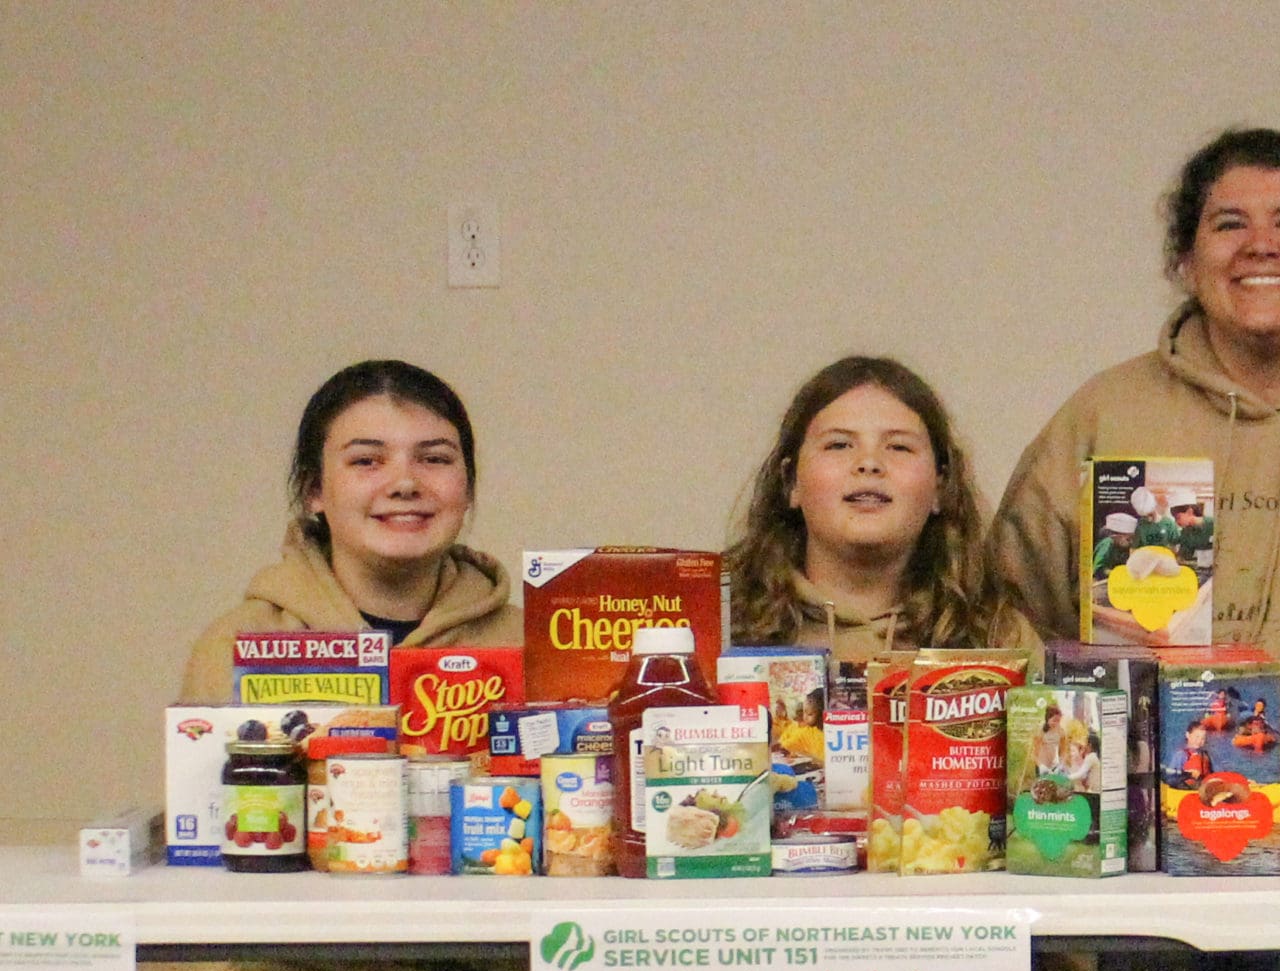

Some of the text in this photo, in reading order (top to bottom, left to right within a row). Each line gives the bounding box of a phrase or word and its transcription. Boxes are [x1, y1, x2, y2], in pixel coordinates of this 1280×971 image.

[600, 595, 682, 616] Honey Nut
[549, 608, 691, 650] Chee
[236, 639, 358, 659] VALUE PACK
[363, 637, 385, 654] 24
[363, 655, 385, 664] BARS
[444, 659, 471, 670] Kraft
[247, 677, 376, 700] NATURE VALLEY
[401, 673, 506, 736] Stove
[925, 691, 1007, 721] IDAHOA
[825, 712, 865, 721] America's
[435, 712, 489, 751] Top
[674, 727, 757, 740] BUMBLE BEE
[827, 730, 869, 751] JIF
[949, 746, 991, 756] BUTTERY
[658, 755, 754, 775] Light Tuna
[932, 756, 1005, 770] HOMESTYLE
[919, 781, 963, 789] MASHED
[1028, 810, 1075, 822] thin mints
[1199, 808, 1249, 820] tagalongs
[178, 818, 194, 831] 16
[463, 823, 506, 835] fruit mix
[10, 932, 122, 948] NEW YORK
[603, 925, 1017, 945] GIRL SCOUTS OF NORTHEAST NEW YORK
[604, 948, 712, 967] SERVICE
[719, 948, 776, 966] UNIT
[784, 947, 818, 965] 151
